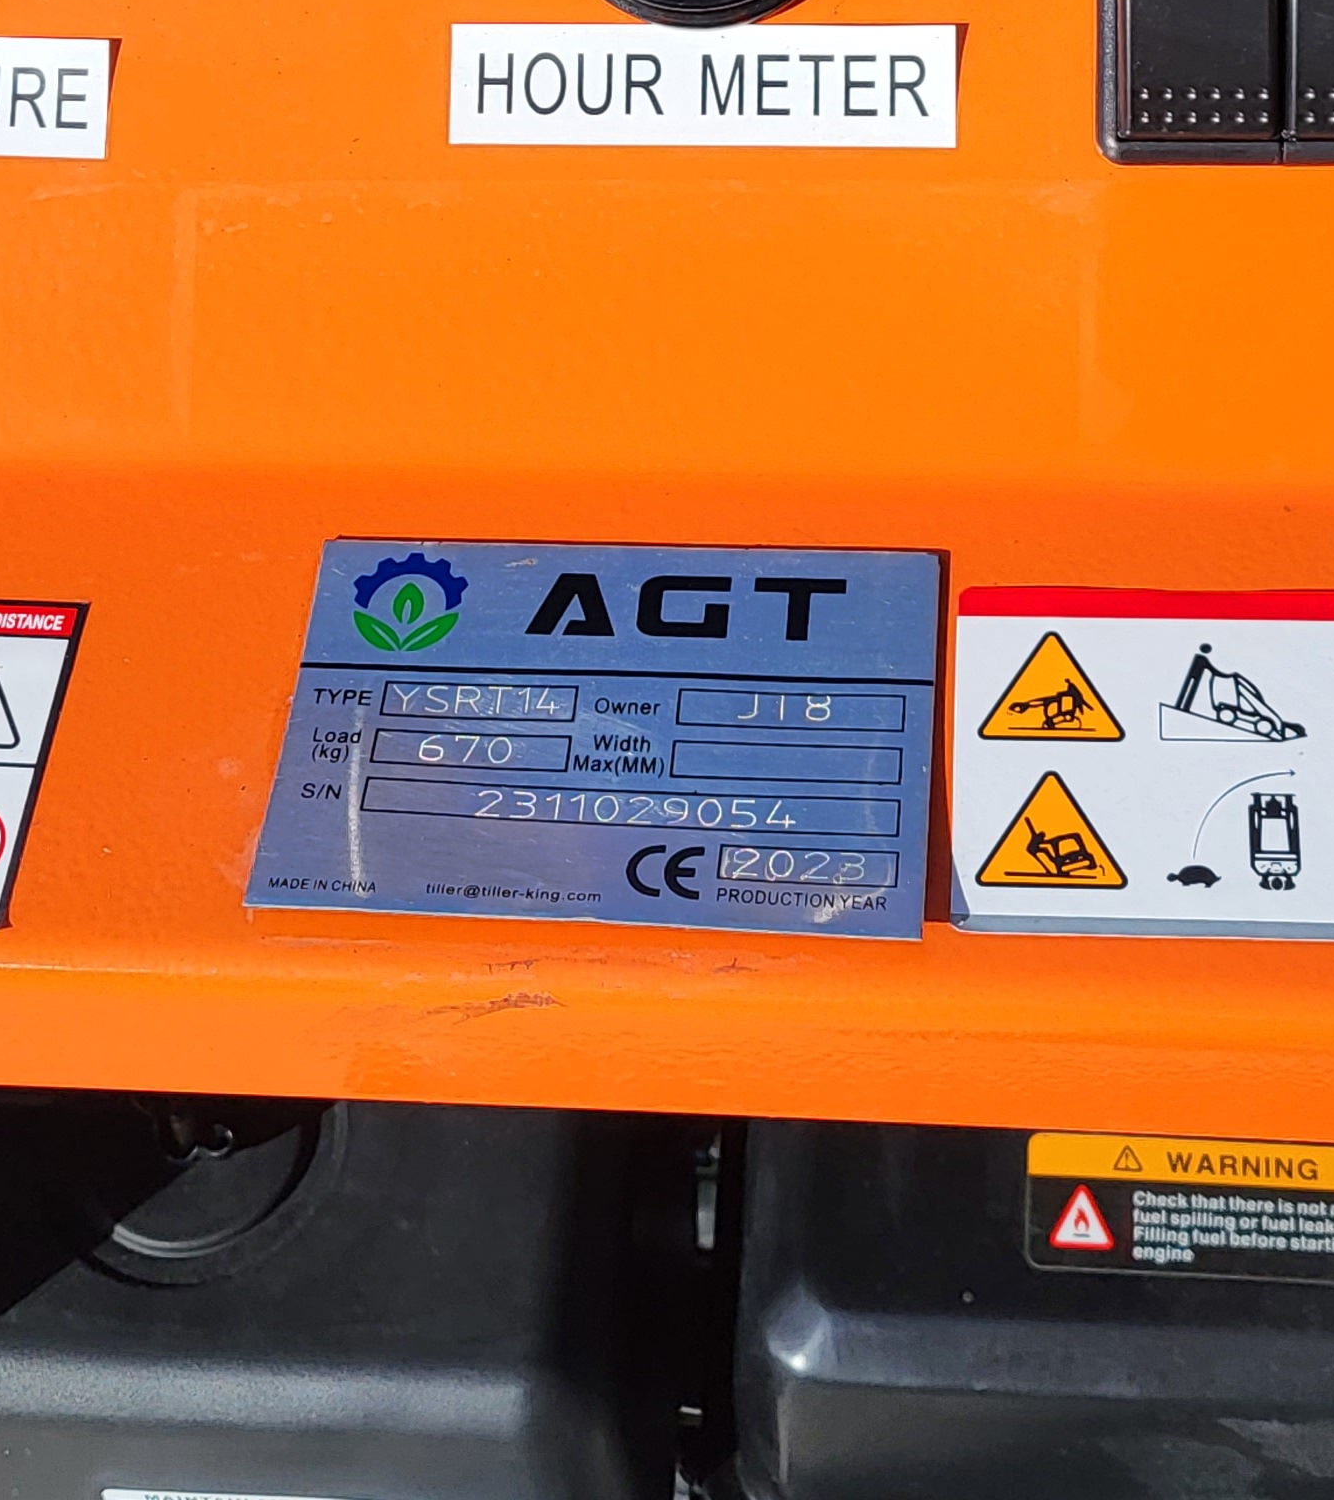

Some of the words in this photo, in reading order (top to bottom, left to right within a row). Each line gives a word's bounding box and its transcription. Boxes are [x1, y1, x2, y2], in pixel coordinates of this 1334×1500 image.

[476, 51, 665, 116] HOUR
[700, 53, 930, 118] METER
[524, 572, 848, 643] AGT
[313, 687, 373, 707] TYPE
[392, 684, 560, 715] YSRT14
[594, 696, 661, 716] Owner
[312, 727, 363, 745] Load
[593, 734, 652, 753] Width
[311, 743, 350, 764] (kg)
[418, 734, 513, 764] 670
[572, 754, 666, 779] Max(MM)
[300, 782, 343, 801] S/N
[473, 788, 797, 829] 2311029054
[625, 844, 706, 900] CE
[731, 847, 866, 881] 2023
[267, 876, 311, 891] MADE
[312, 878, 329, 892] IN
[330, 879, 377, 894] CHINA
[425, 881, 602, 904] tiller@tiller-king.com
[716, 887, 836, 909] PRODUCTION
[839, 894, 888, 911] YEAR
[1166, 1151, 1319, 1181] WARNING
[1132, 1189, 1188, 1209] Check
[1191, 1192, 1227, 1211] that
[1228, 1194, 1276, 1214] there
[1277, 1197, 1295, 1214] is
[1297, 1200, 1329, 1217] not
[1132, 1208, 1168, 1224] fuel
[1170, 1211, 1236, 1232] spilling
[1238, 1215, 1259, 1230] or
[1261, 1214, 1297, 1234] fuel
[1132, 1225, 1190, 1246] Filling
[1192, 1228, 1227, 1247] fuel
[1228, 1231, 1288, 1249] before
[1132, 1244, 1196, 1265] engine
